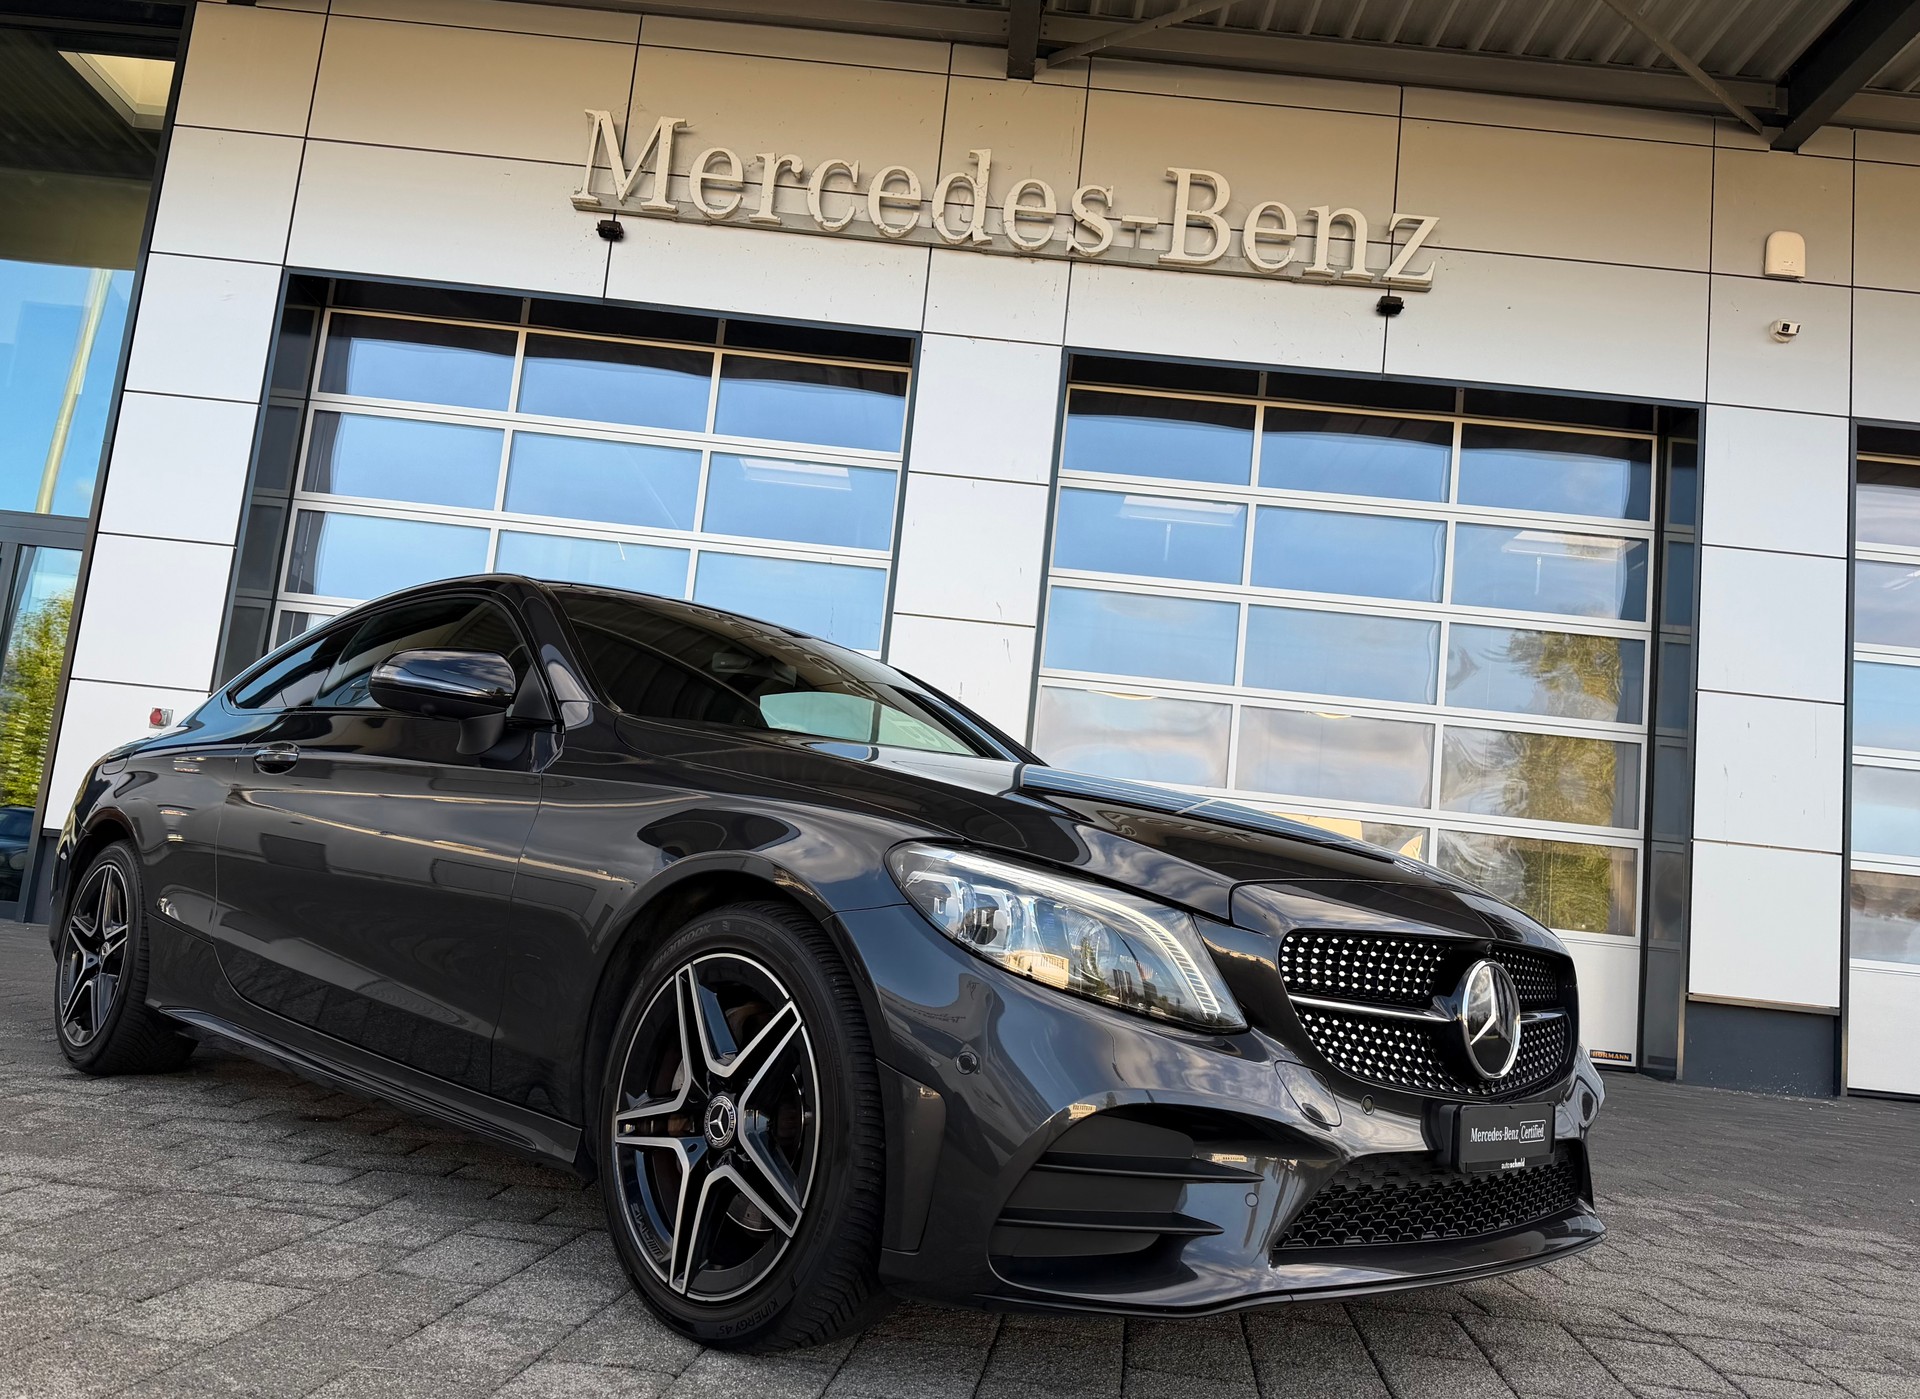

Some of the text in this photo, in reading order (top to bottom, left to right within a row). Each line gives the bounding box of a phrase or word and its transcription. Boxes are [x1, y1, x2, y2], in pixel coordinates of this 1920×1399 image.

[569, 108, 1441, 285] Mercedes-Benz
[1470, 1124, 1544, 1142] Mercedes-Benz Certified
